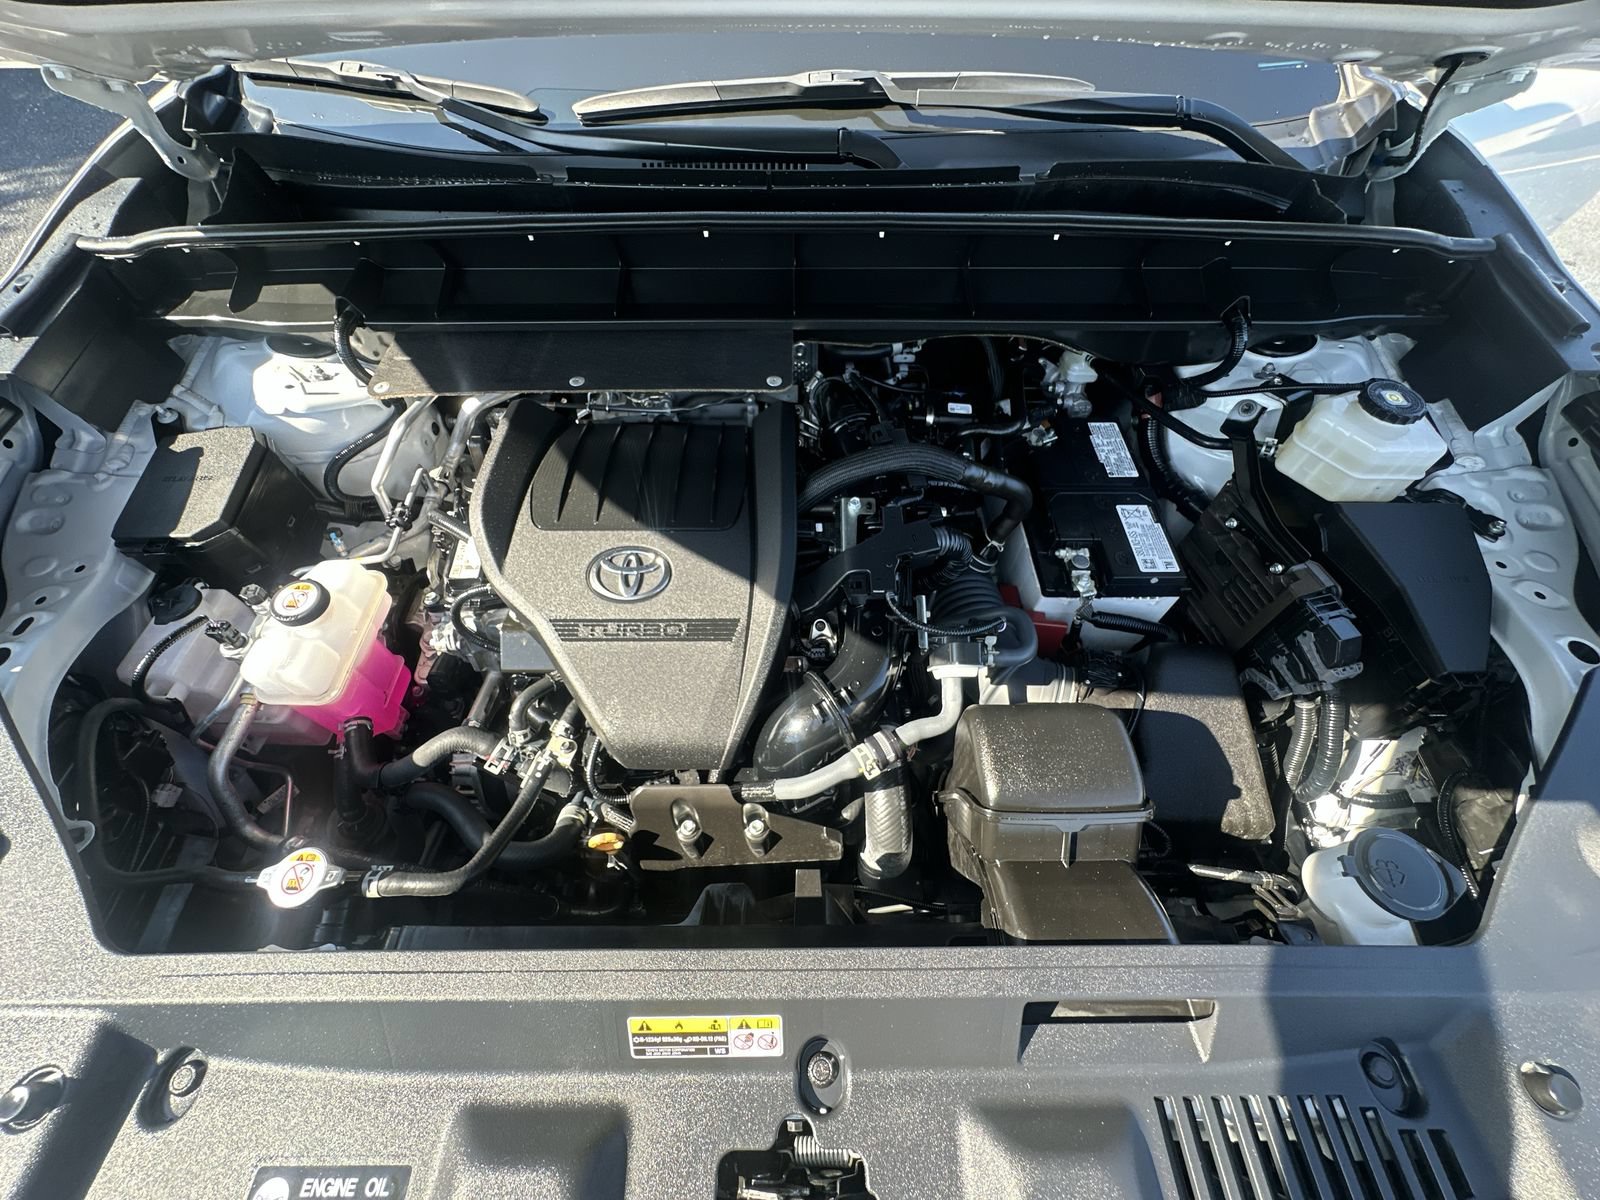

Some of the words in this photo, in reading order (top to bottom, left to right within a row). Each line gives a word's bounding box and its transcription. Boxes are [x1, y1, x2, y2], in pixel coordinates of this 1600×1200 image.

[578, 622, 688, 639] TURBO
[299, 1177, 359, 1198] ENGINE
[364, 1177, 390, 1198] OIL
